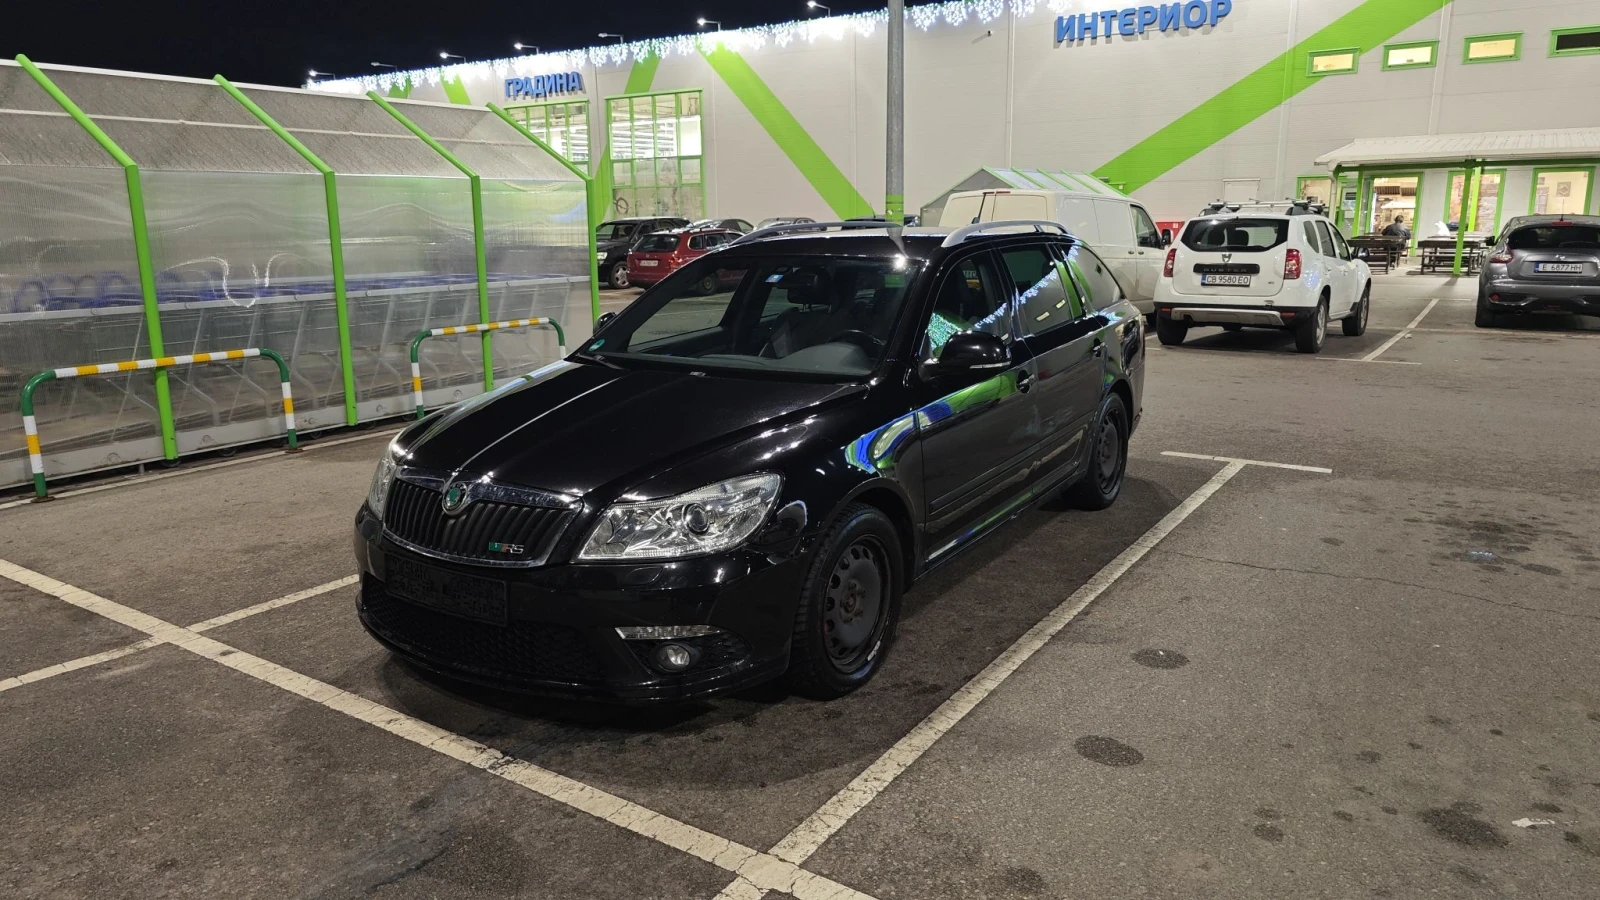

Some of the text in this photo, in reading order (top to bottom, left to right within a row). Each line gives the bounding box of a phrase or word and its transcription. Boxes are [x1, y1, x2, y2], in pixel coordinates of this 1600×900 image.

[1056, 0, 1232, 43] ИНТЕРИОР
[505, 71, 583, 98] ГРАДИНА
[1206, 275, 1217, 283] CB
[1218, 275, 1237, 284] 9580
